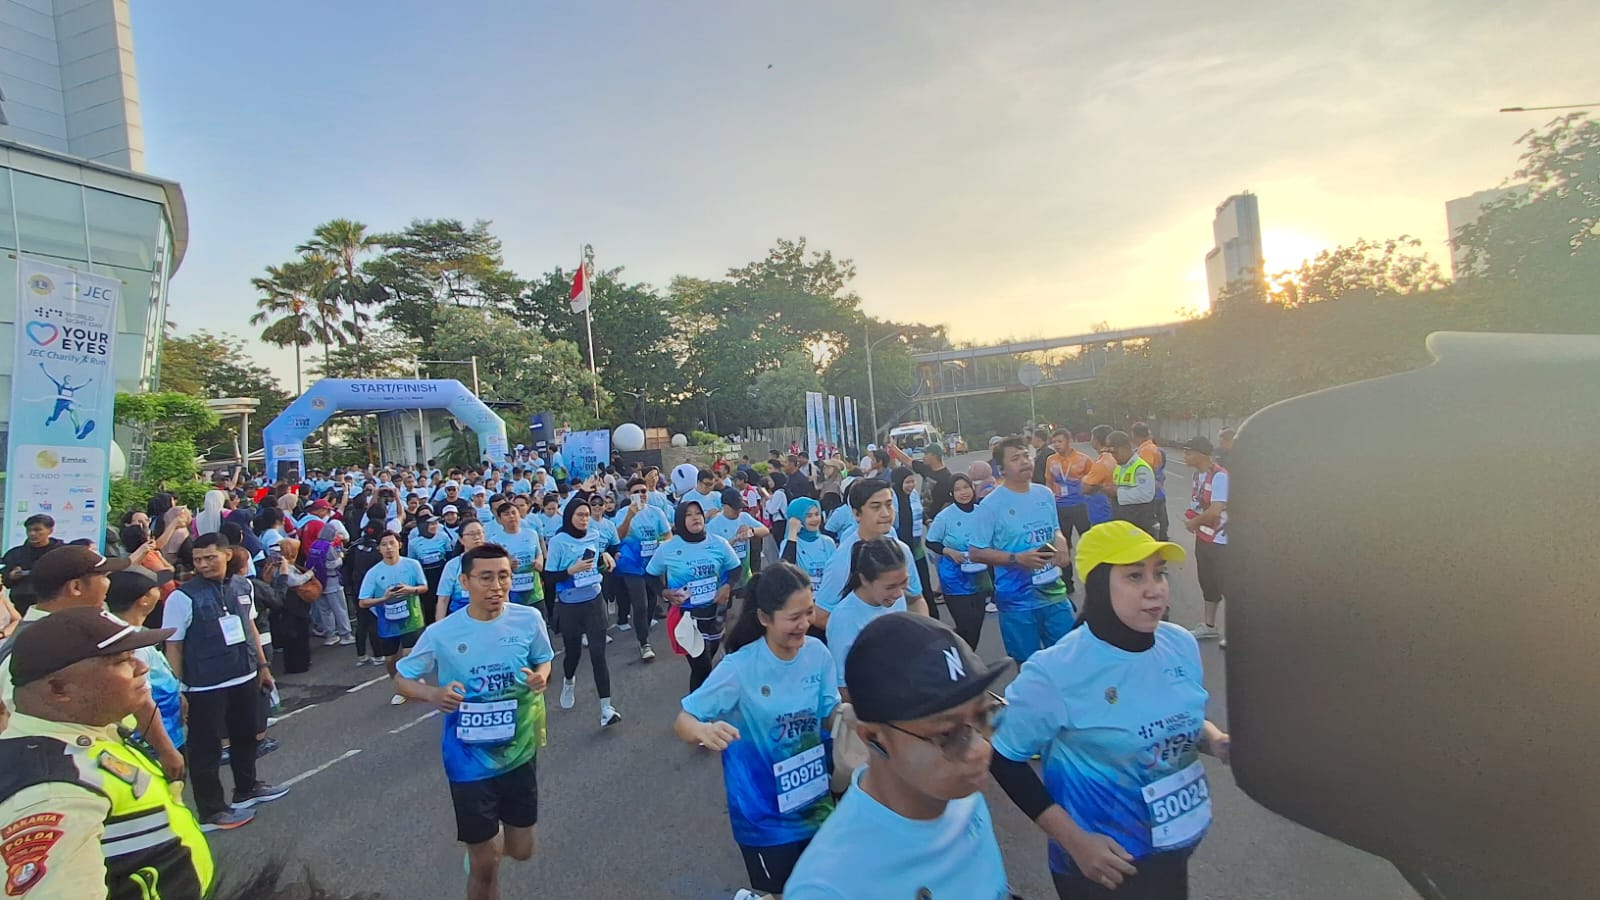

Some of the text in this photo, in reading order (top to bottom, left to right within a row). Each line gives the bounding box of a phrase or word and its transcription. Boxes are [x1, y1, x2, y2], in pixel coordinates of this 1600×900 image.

[83, 286, 112, 301] JEC
[62, 326, 109, 344] YOUR
[62, 339, 107, 356] EYES
[27, 349, 107, 366] JEC Charity Run
[351, 382, 438, 394] START/FINISH
[486, 671, 516, 682] YOUR
[460, 711, 513, 727] 50536
[788, 718, 818, 730] YOUR
[786, 724, 816, 739] EYES
[780, 759, 824, 791] 50975
[1154, 778, 1209, 824] 50024
[6, 814, 58, 835] JAKARTA
